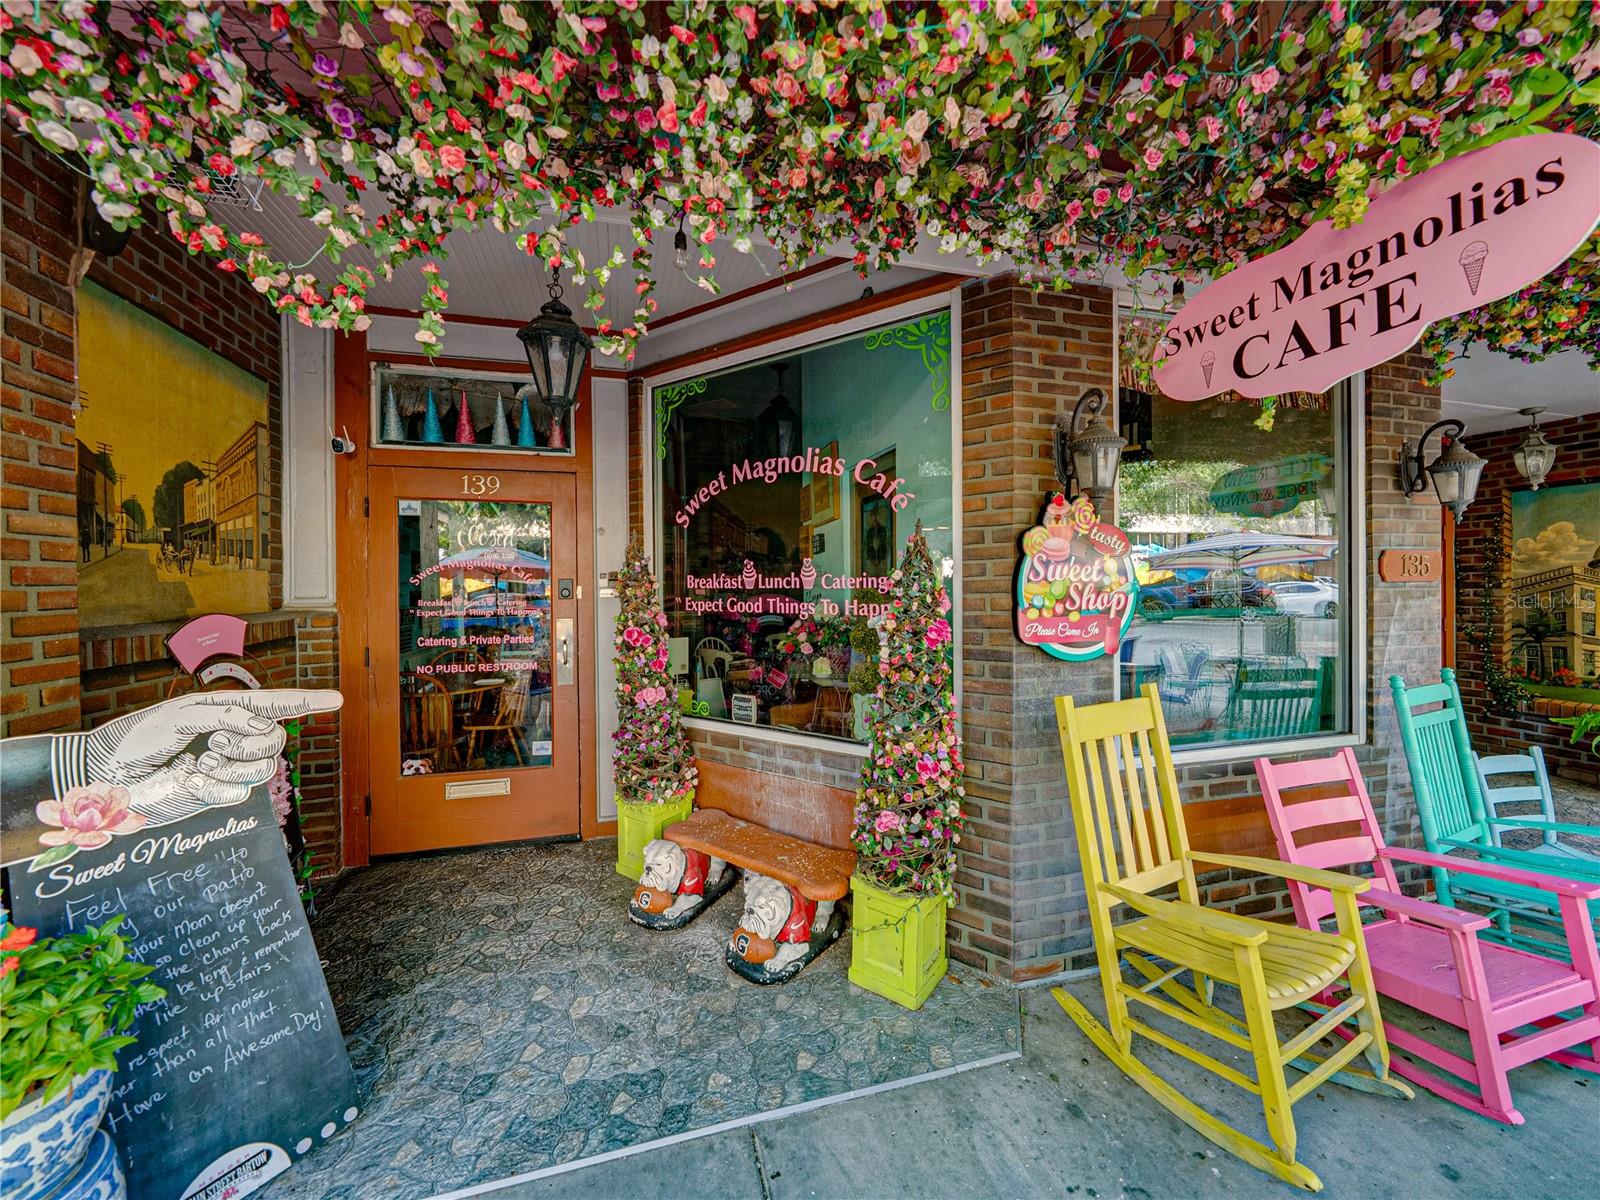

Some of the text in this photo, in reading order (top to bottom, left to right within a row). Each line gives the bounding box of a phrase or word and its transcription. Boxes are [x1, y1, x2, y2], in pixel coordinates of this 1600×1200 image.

[1166, 157, 1566, 356] Sweet Magnolias
[1233, 272, 1422, 379] CAFE
[461, 475, 500, 495] 139
[675, 447, 916, 529] Sweet Magnolias Café
[1090, 526, 1127, 555] tasty
[409, 564, 446, 586] Sweet
[448, 558, 508, 571] Magnolias
[1029, 553, 1104, 581] Sweet
[1401, 553, 1430, 577] 135
[687, 571, 889, 594] Breakfast Lunch Catering
[444, 609, 467, 617] Good
[469, 609, 494, 617] Things
[497, 600, 527, 608] Catering
[685, 598, 723, 616] Expect
[727, 598, 763, 613] Good
[767, 598, 815, 620] Things
[820, 599, 839, 614] To
[845, 599, 890, 622] Happ
[1065, 583, 1127, 618] Shop
[417, 634, 535, 648] Catering & Private Parties
[1025, 621, 1099, 638] Please Come In
[417, 662, 538, 675] NO PUBLIC RESTROOM
[35, 816, 258, 899] Sweet Magnolias
[66, 887, 127, 930] Feel
[148, 863, 212, 896] Free
[154, 867, 254, 919] our patio
[155, 955, 172, 968] so
[228, 919, 246, 933] up
[253, 899, 282, 926] your
[165, 964, 194, 979] the
[259, 910, 291, 936] back
[254, 926, 304, 960] remember
[736, 934, 750, 956] G
[128, 935, 166, 963] your
[156, 1004, 188, 1026] live
[128, 1025, 191, 1072] respect
[204, 1012, 223, 1030] for
[152, 1048, 197, 1078] than
[205, 1025, 229, 1049] all
[108, 1001, 328, 1133] Have an Awesome Day!
